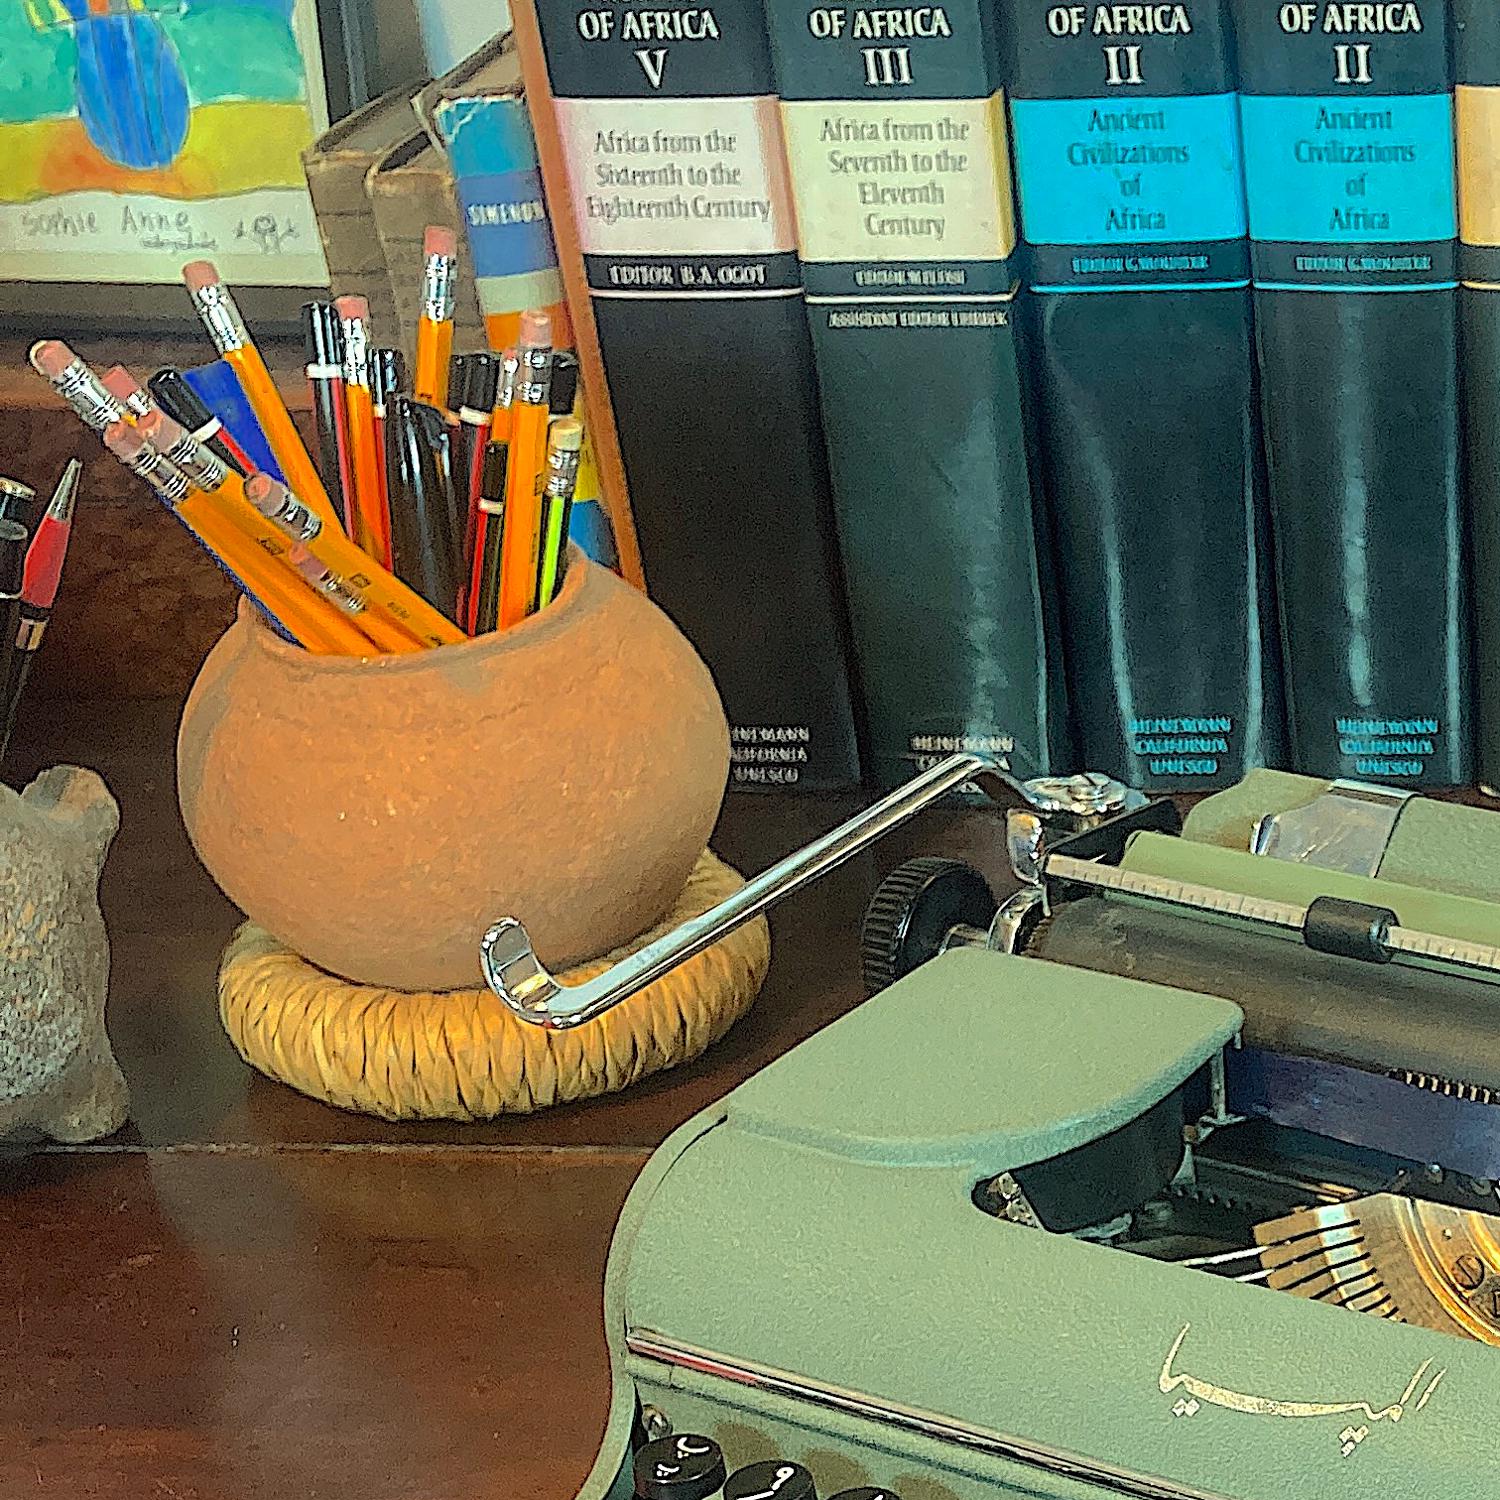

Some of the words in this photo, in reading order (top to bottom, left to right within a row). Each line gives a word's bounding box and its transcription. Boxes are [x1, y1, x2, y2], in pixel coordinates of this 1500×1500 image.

[578, 9, 614, 40] OF
[622, 9, 720, 40] AFRICA
[809, 8, 846, 38] OF
[853, 8, 952, 38] AFRICA
[1048, 6, 1085, 35] OF
[1093, 5, 1191, 34] AFRICA
[1280, 3, 1316, 32] OF
[1323, 3, 1422, 32] AFRICA
[634, 48, 669, 89] V
[860, 47, 914, 86] III
[1103, 45, 1144, 85] II
[1334, 44, 1372, 83] II
[819, 117, 880, 142] Africa
[882, 117, 934, 142] from
[937, 117, 970, 142] the
[1088, 109, 1164, 132] Ancient
[1315, 106, 1392, 130] Ancient
[593, 129, 650, 154] Africa
[653, 129, 701, 154] from
[705, 129, 737, 153] the
[1067, 142, 1190, 166] Civilizations
[1294, 139, 1415, 163] Civilizations
[595, 162, 683, 187] Sixteenth
[687, 165, 709, 187] to
[711, 161, 742, 186] the
[828, 149, 908, 174] Seventh
[912, 151, 933, 174] to
[935, 149, 968, 173] the
[858, 181, 945, 205] Eleventh
[1120, 173, 1140, 196] of
[1345, 173, 1367, 196] of
[586, 194, 690, 225] Eighteenth
[692, 194, 771, 223] Century
[1105, 208, 1166, 231] Africa
[1329, 207, 1389, 231] Africa
[864, 212, 945, 241] Century
